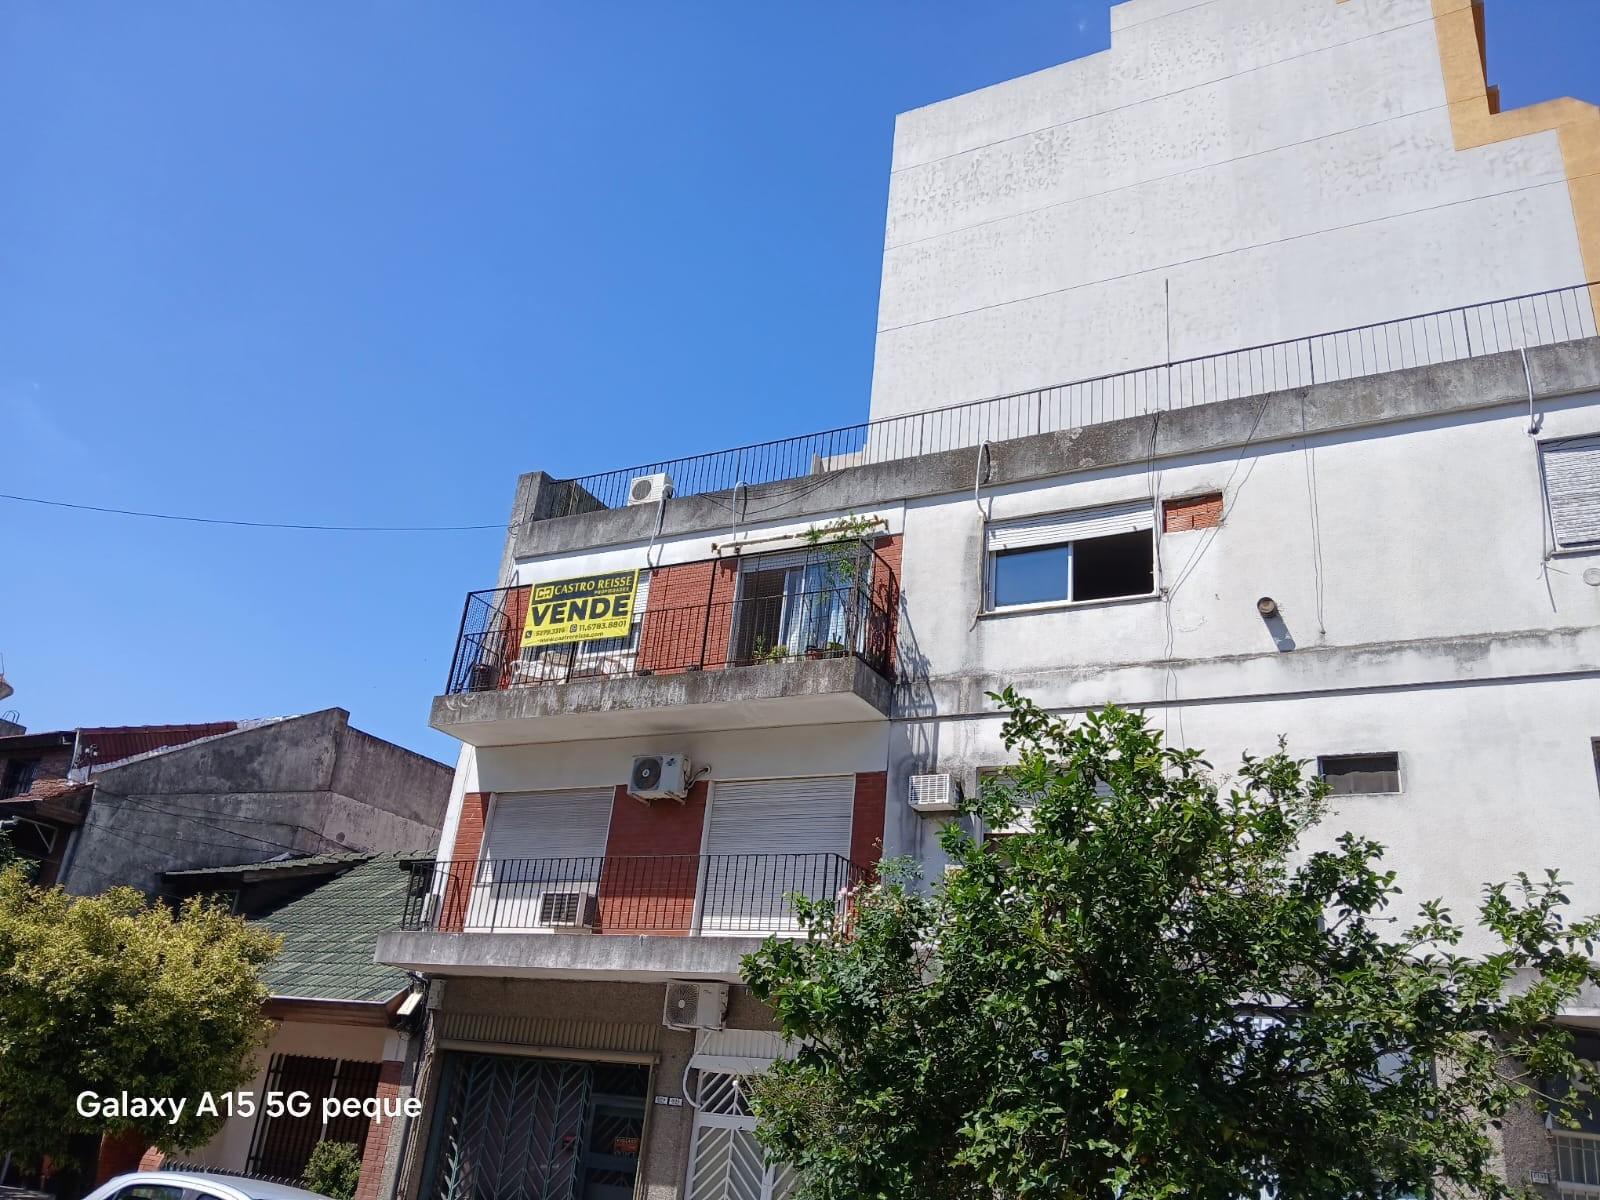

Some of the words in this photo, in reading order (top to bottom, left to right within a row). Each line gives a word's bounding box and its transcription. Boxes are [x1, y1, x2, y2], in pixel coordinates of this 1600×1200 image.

[554, 580, 595, 595] CASTRO
[597, 576, 633, 589] REISSE
[531, 594, 631, 627] VENDE
